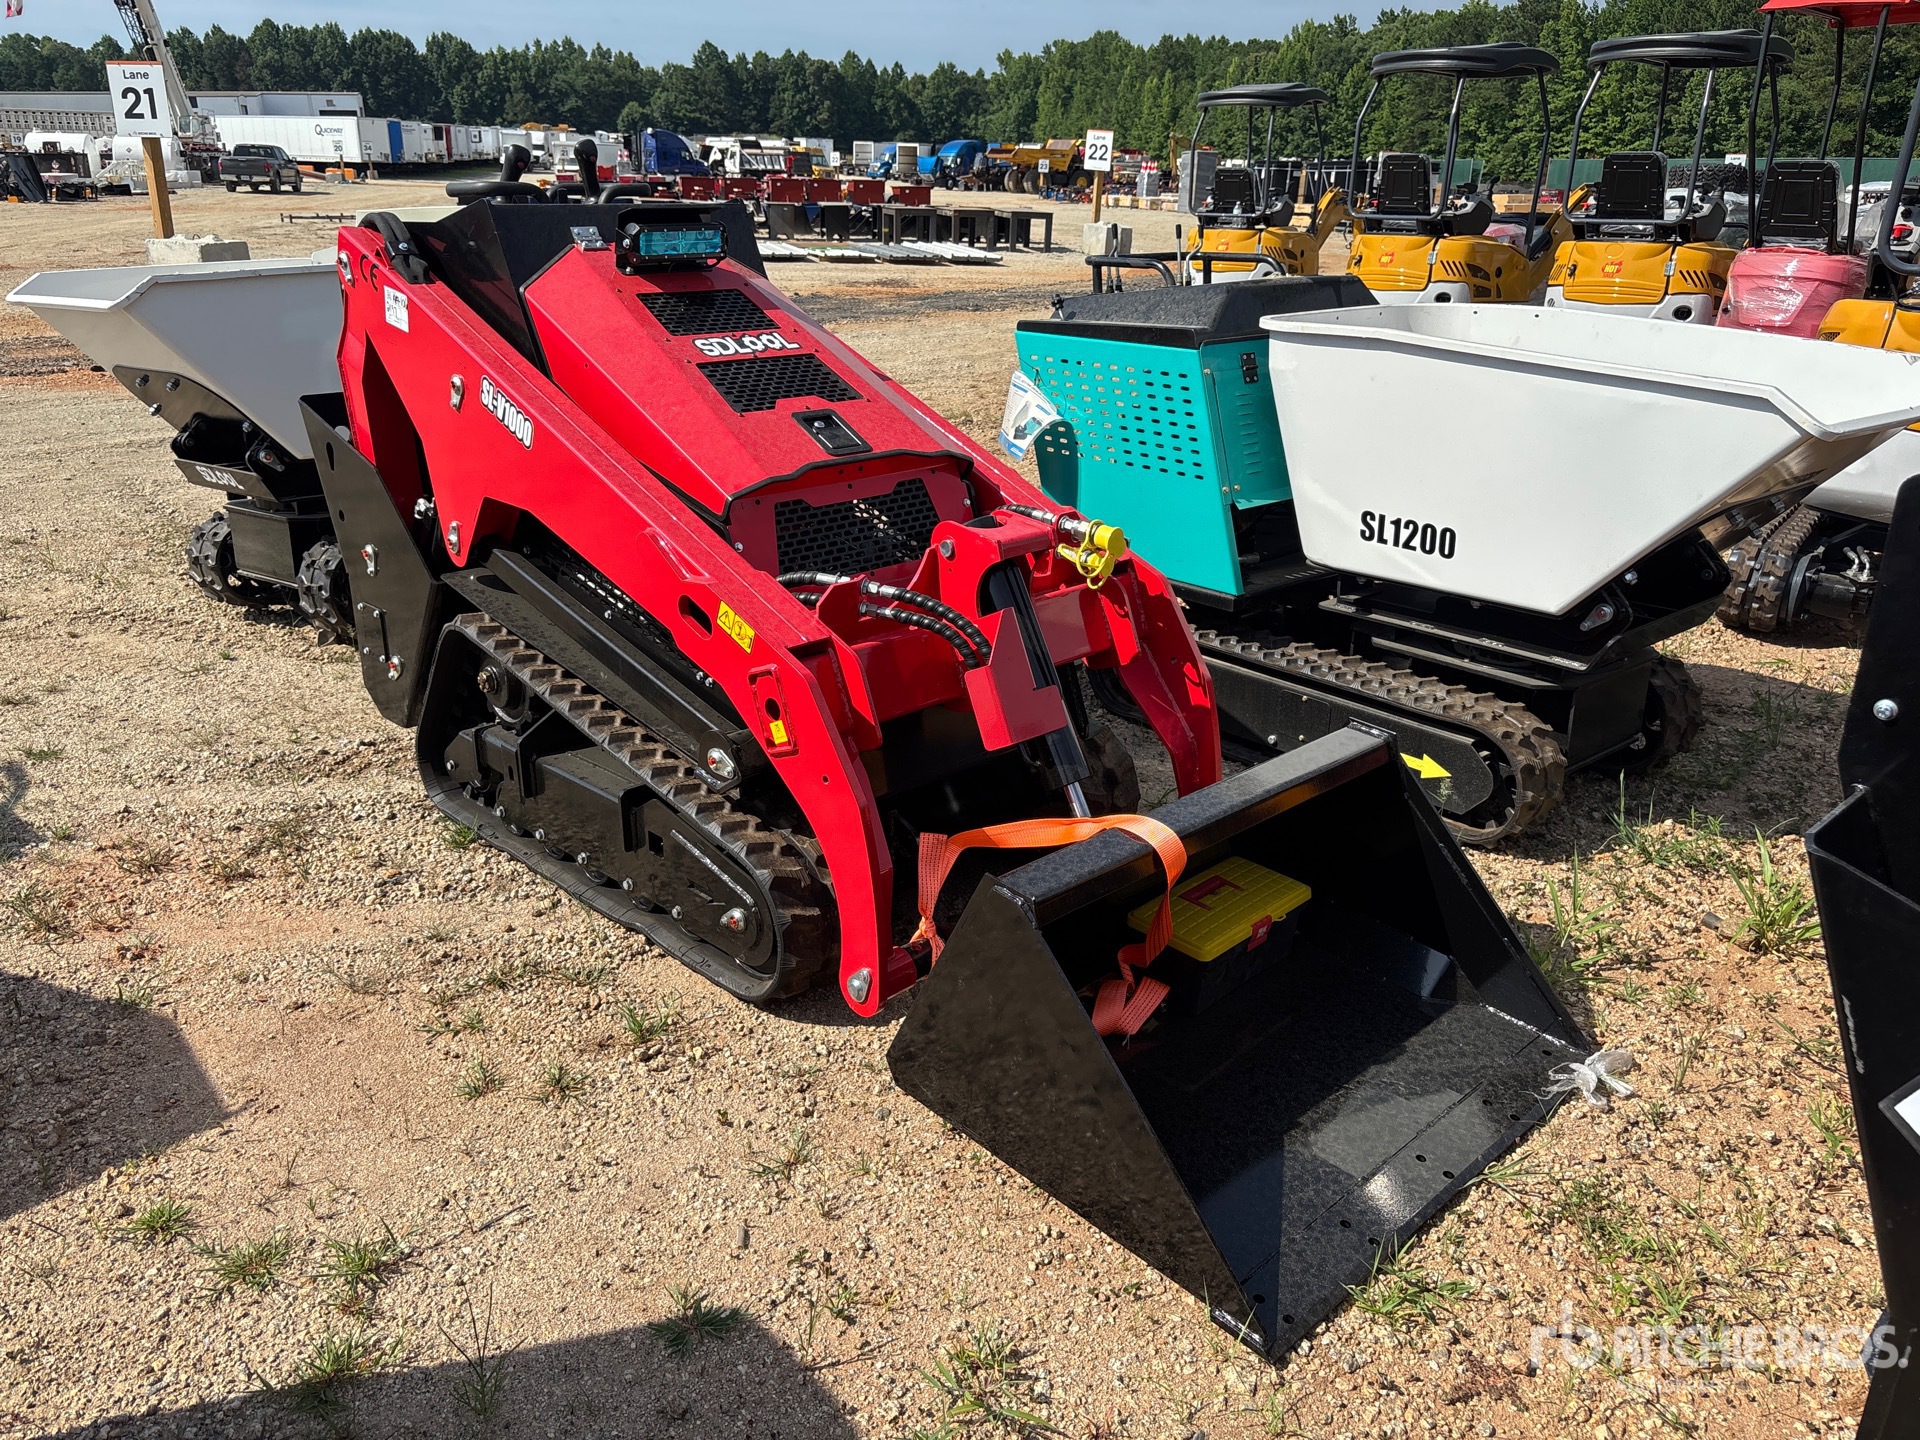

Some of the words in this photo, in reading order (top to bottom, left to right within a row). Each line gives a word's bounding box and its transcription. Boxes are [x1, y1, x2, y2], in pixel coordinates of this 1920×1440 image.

[122, 69, 149, 80] Lane
[121, 86, 158, 120] 21
[12, 135, 22, 143] 19
[333, 144, 343, 152] 20
[363, 144, 373, 152] 34
[1087, 143, 1109, 161] 22
[1604, 264, 1619, 273] HOT
[481, 376, 533, 449] SL-V1000
[1359, 510, 1457, 560] SL1200
